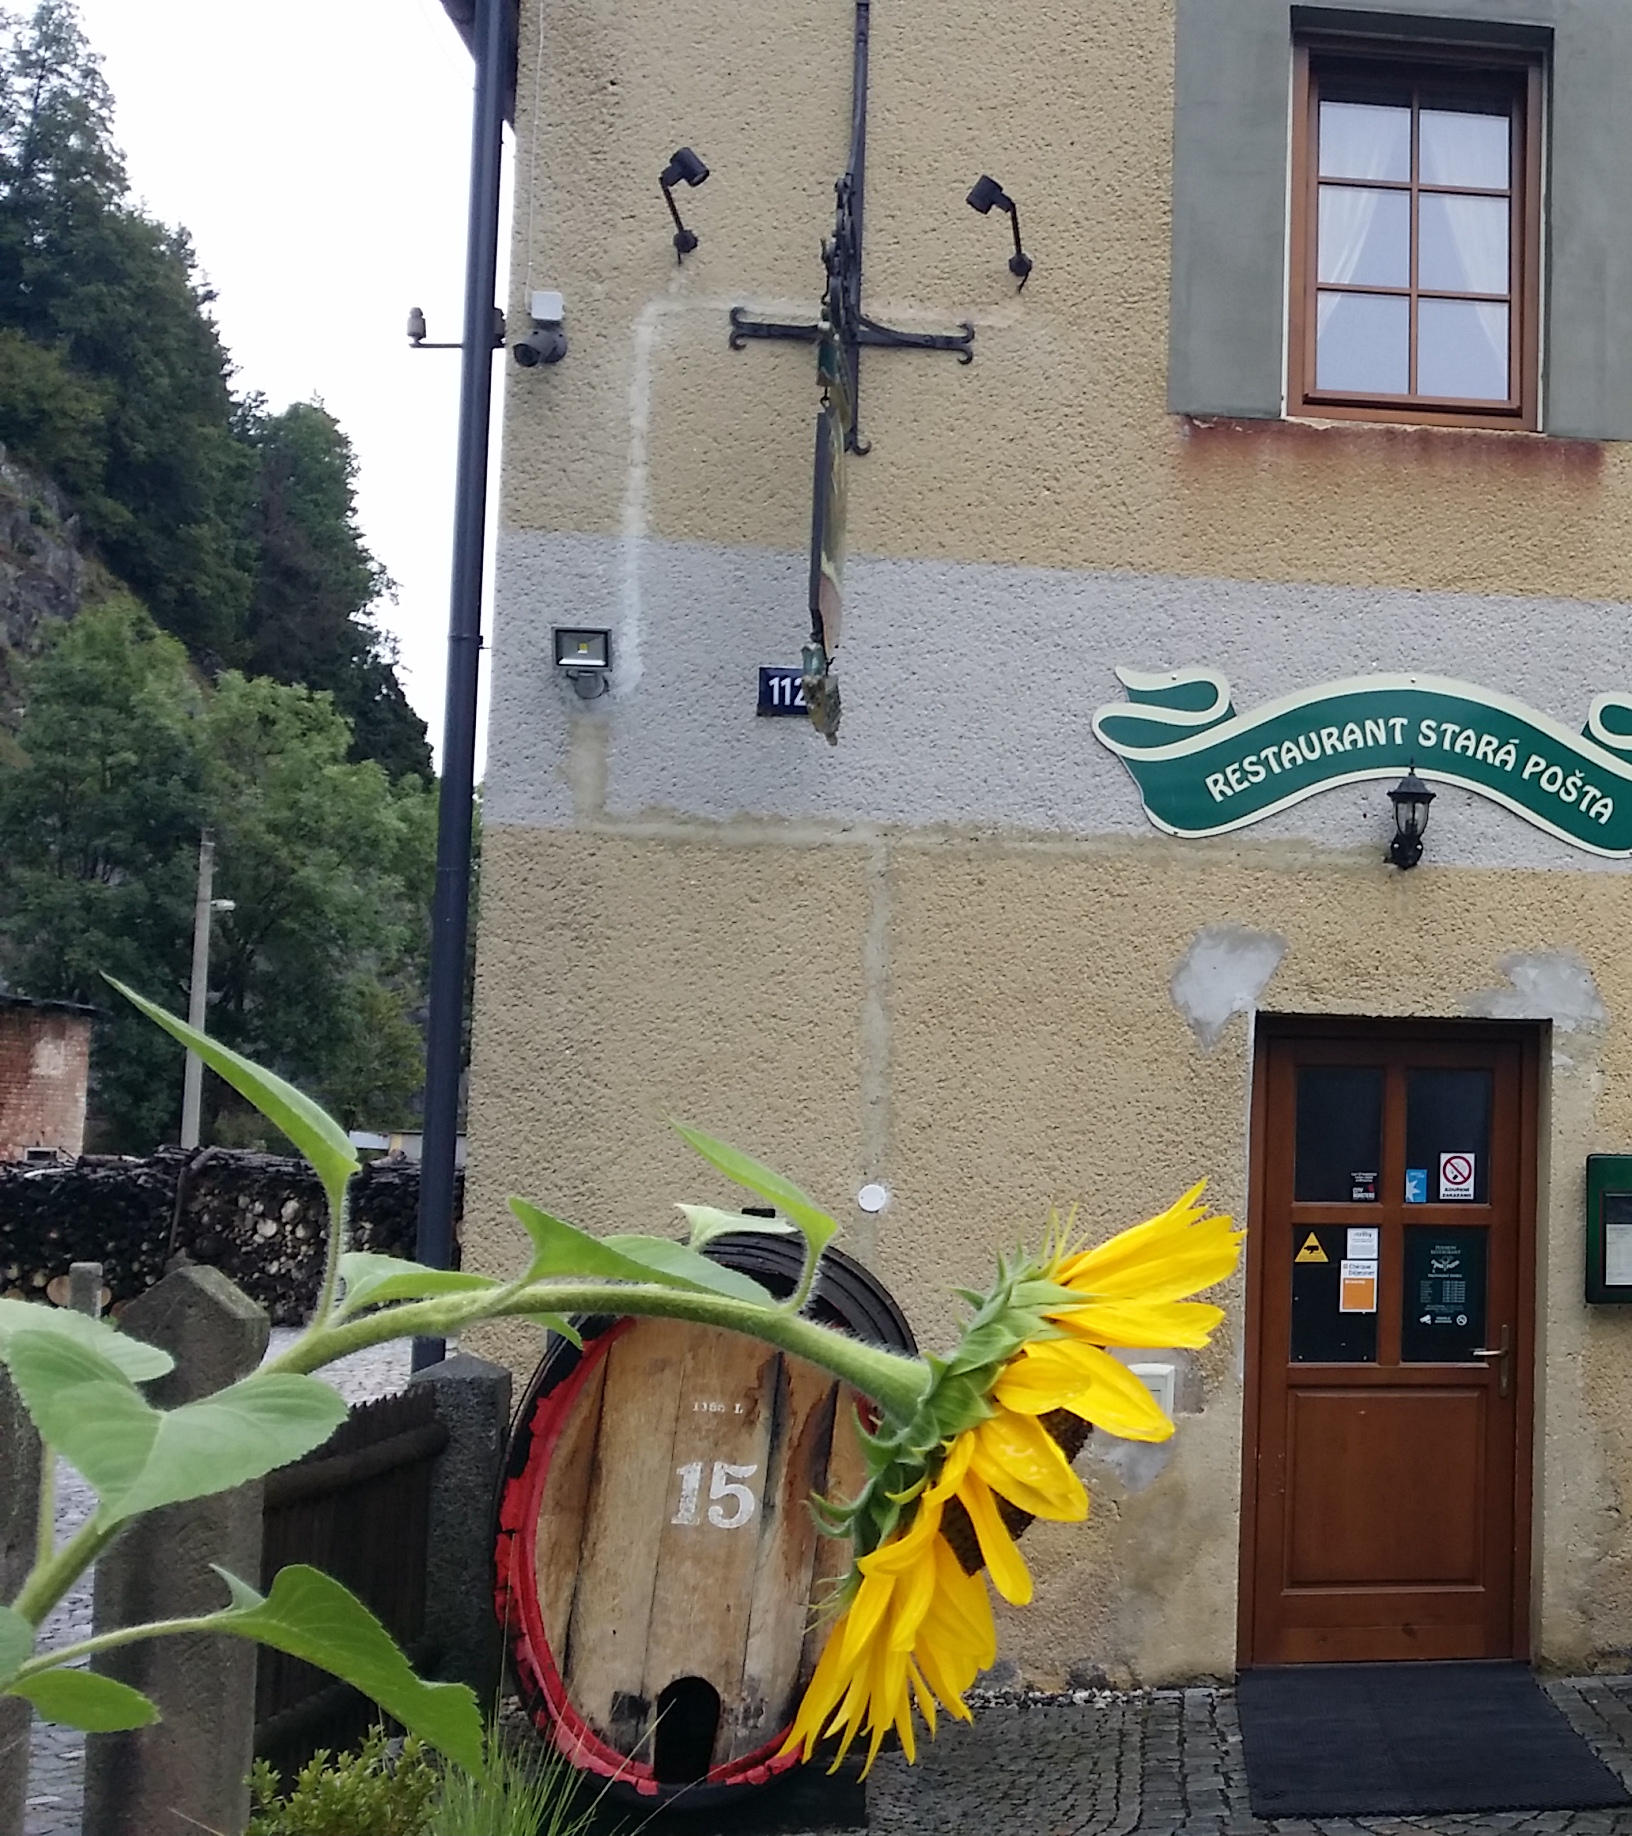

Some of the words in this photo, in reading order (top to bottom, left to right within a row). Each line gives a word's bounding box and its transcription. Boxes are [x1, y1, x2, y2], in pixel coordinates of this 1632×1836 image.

[1205, 716, 1409, 803] RESTAURANT
[1417, 718, 1517, 773] STARÁ
[1520, 754, 1616, 825] POŠTA
[670, 1461, 759, 1529] 15
